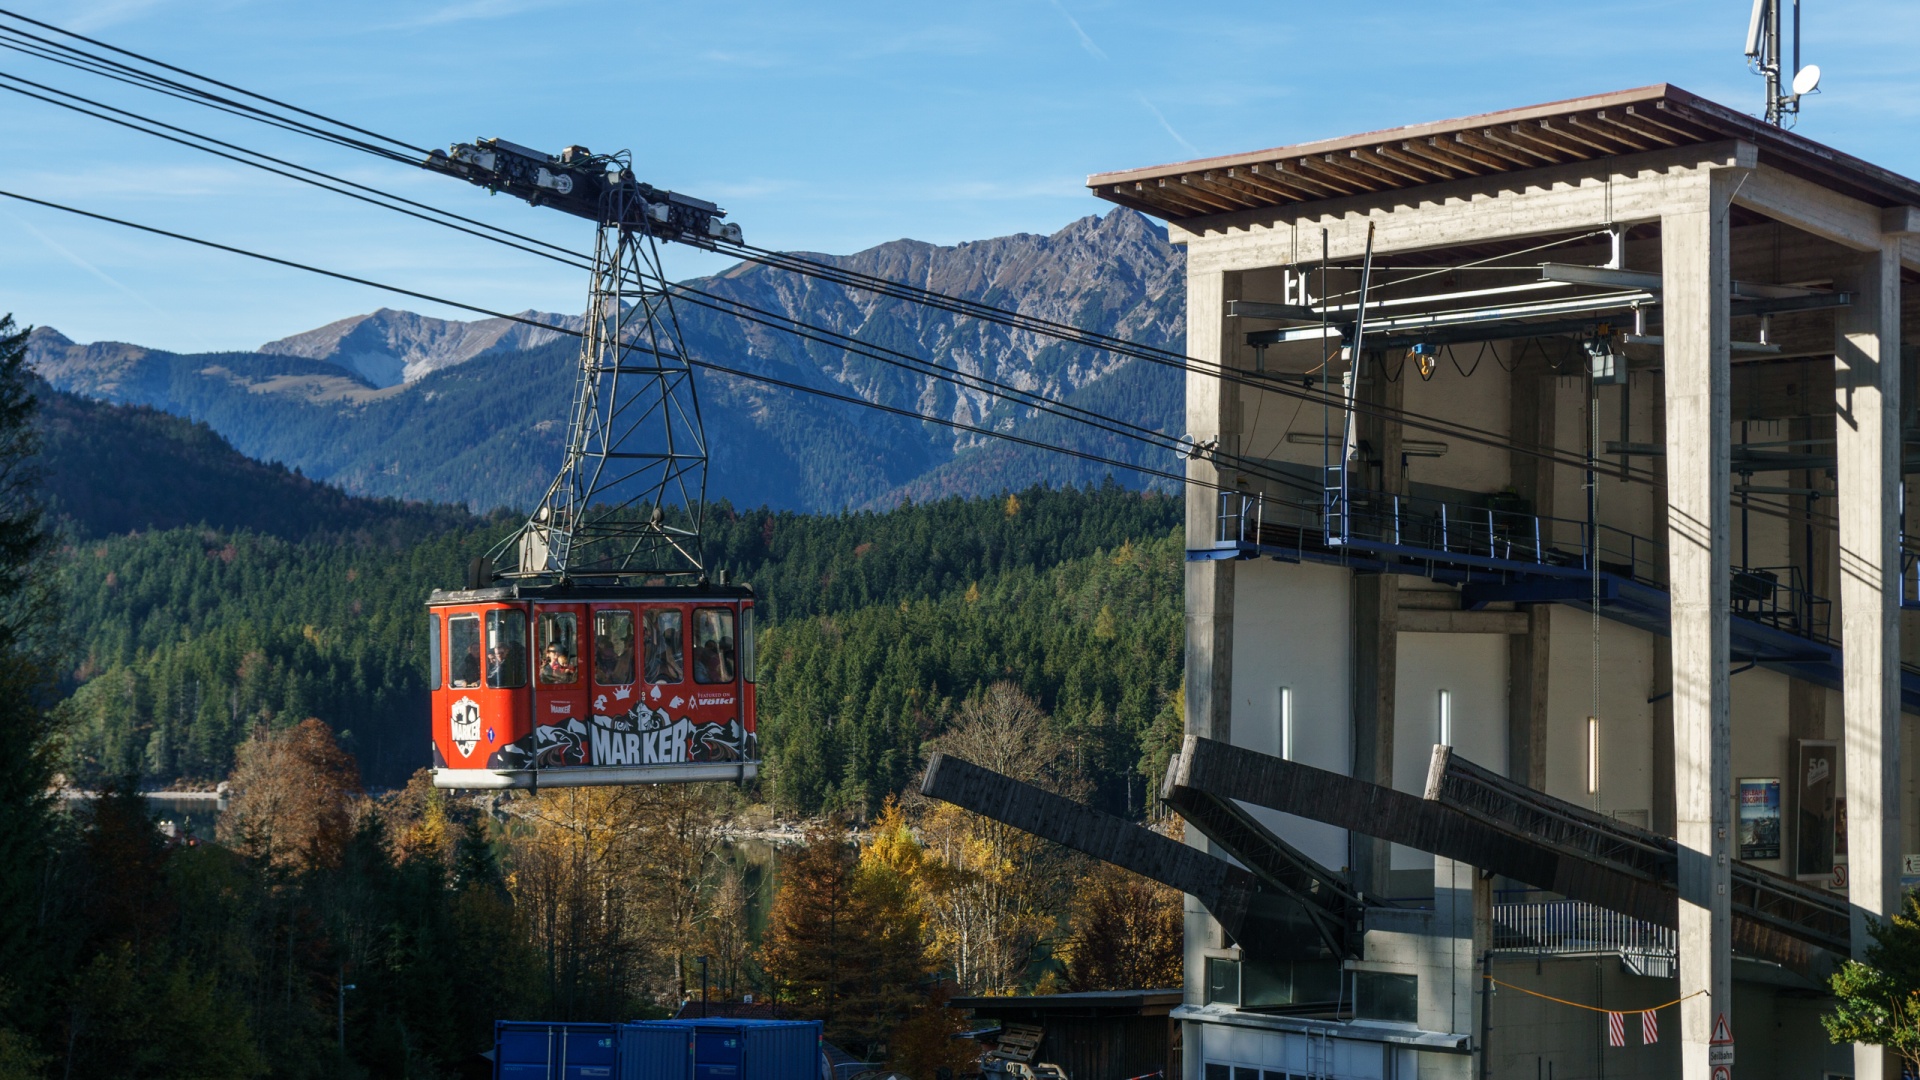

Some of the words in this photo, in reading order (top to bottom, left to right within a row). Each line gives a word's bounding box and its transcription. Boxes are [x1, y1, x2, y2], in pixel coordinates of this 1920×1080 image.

[550, 704, 571, 714] MARKER
[451, 717, 481, 741] MARKER
[489, 730, 493, 740] 1
[591, 718, 688, 766] MARKER
[1711, 1051, 1733, 1061] Seilbahn
